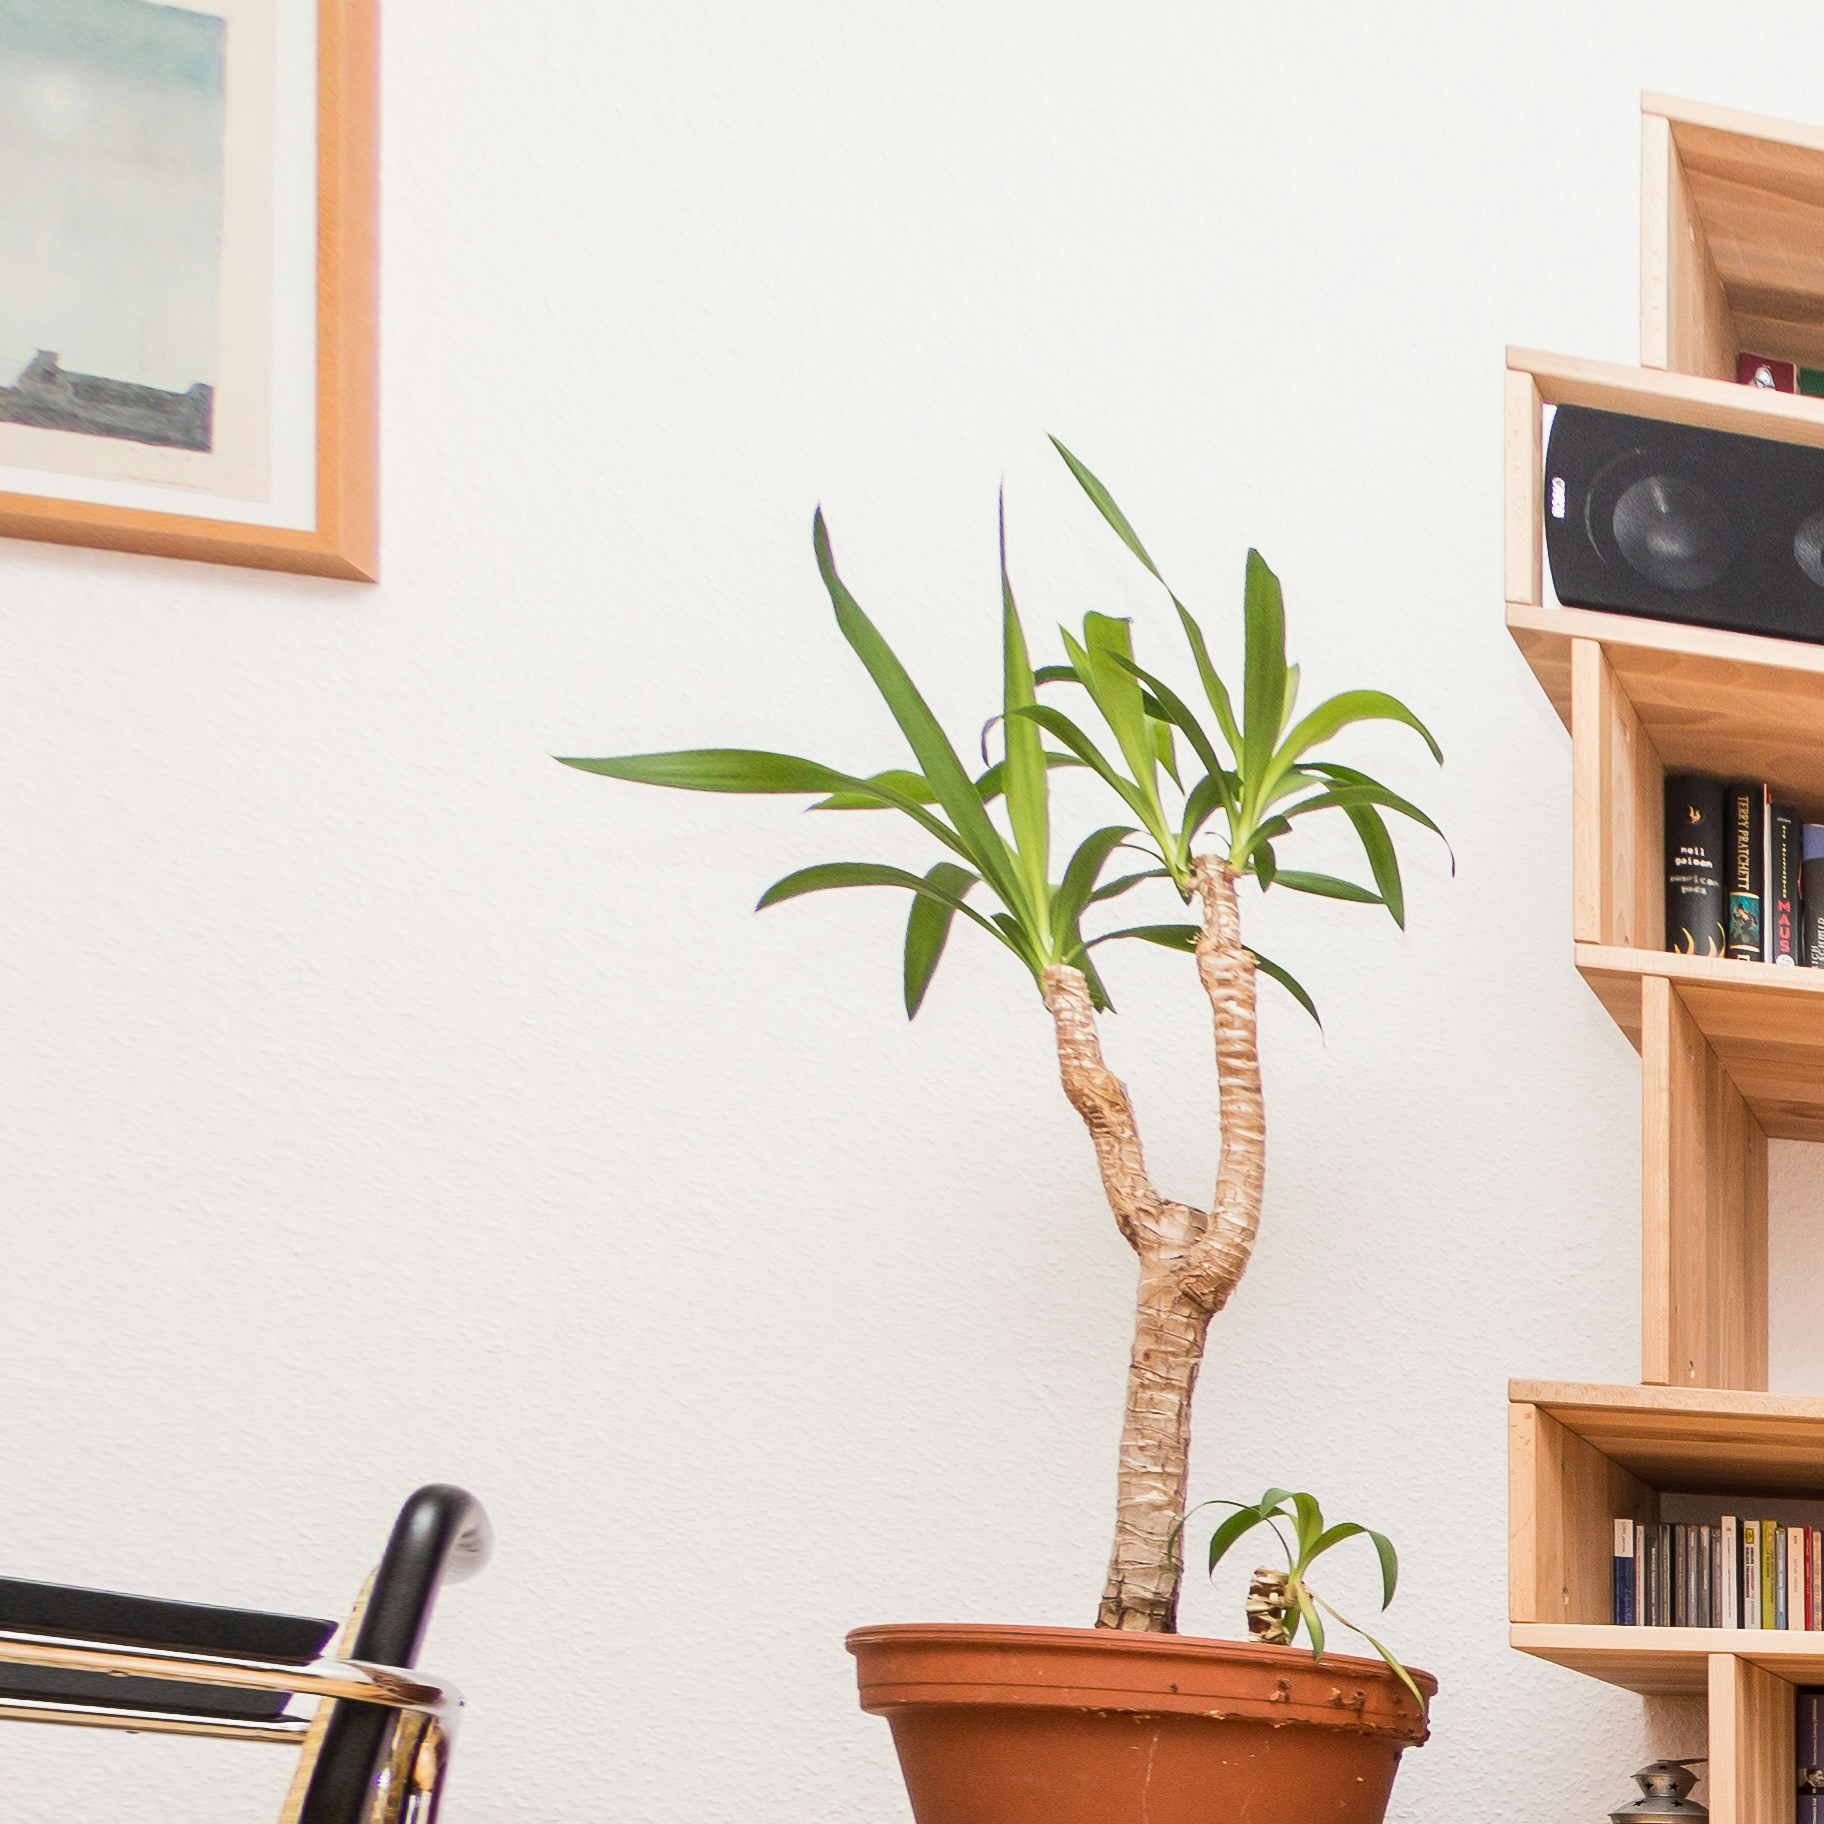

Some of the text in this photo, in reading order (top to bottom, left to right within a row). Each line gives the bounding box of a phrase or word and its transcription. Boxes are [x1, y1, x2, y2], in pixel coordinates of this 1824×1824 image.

[1736, 794, 1750, 891] TERRY PRATCHETT
[1777, 898, 1791, 954] MAUS
